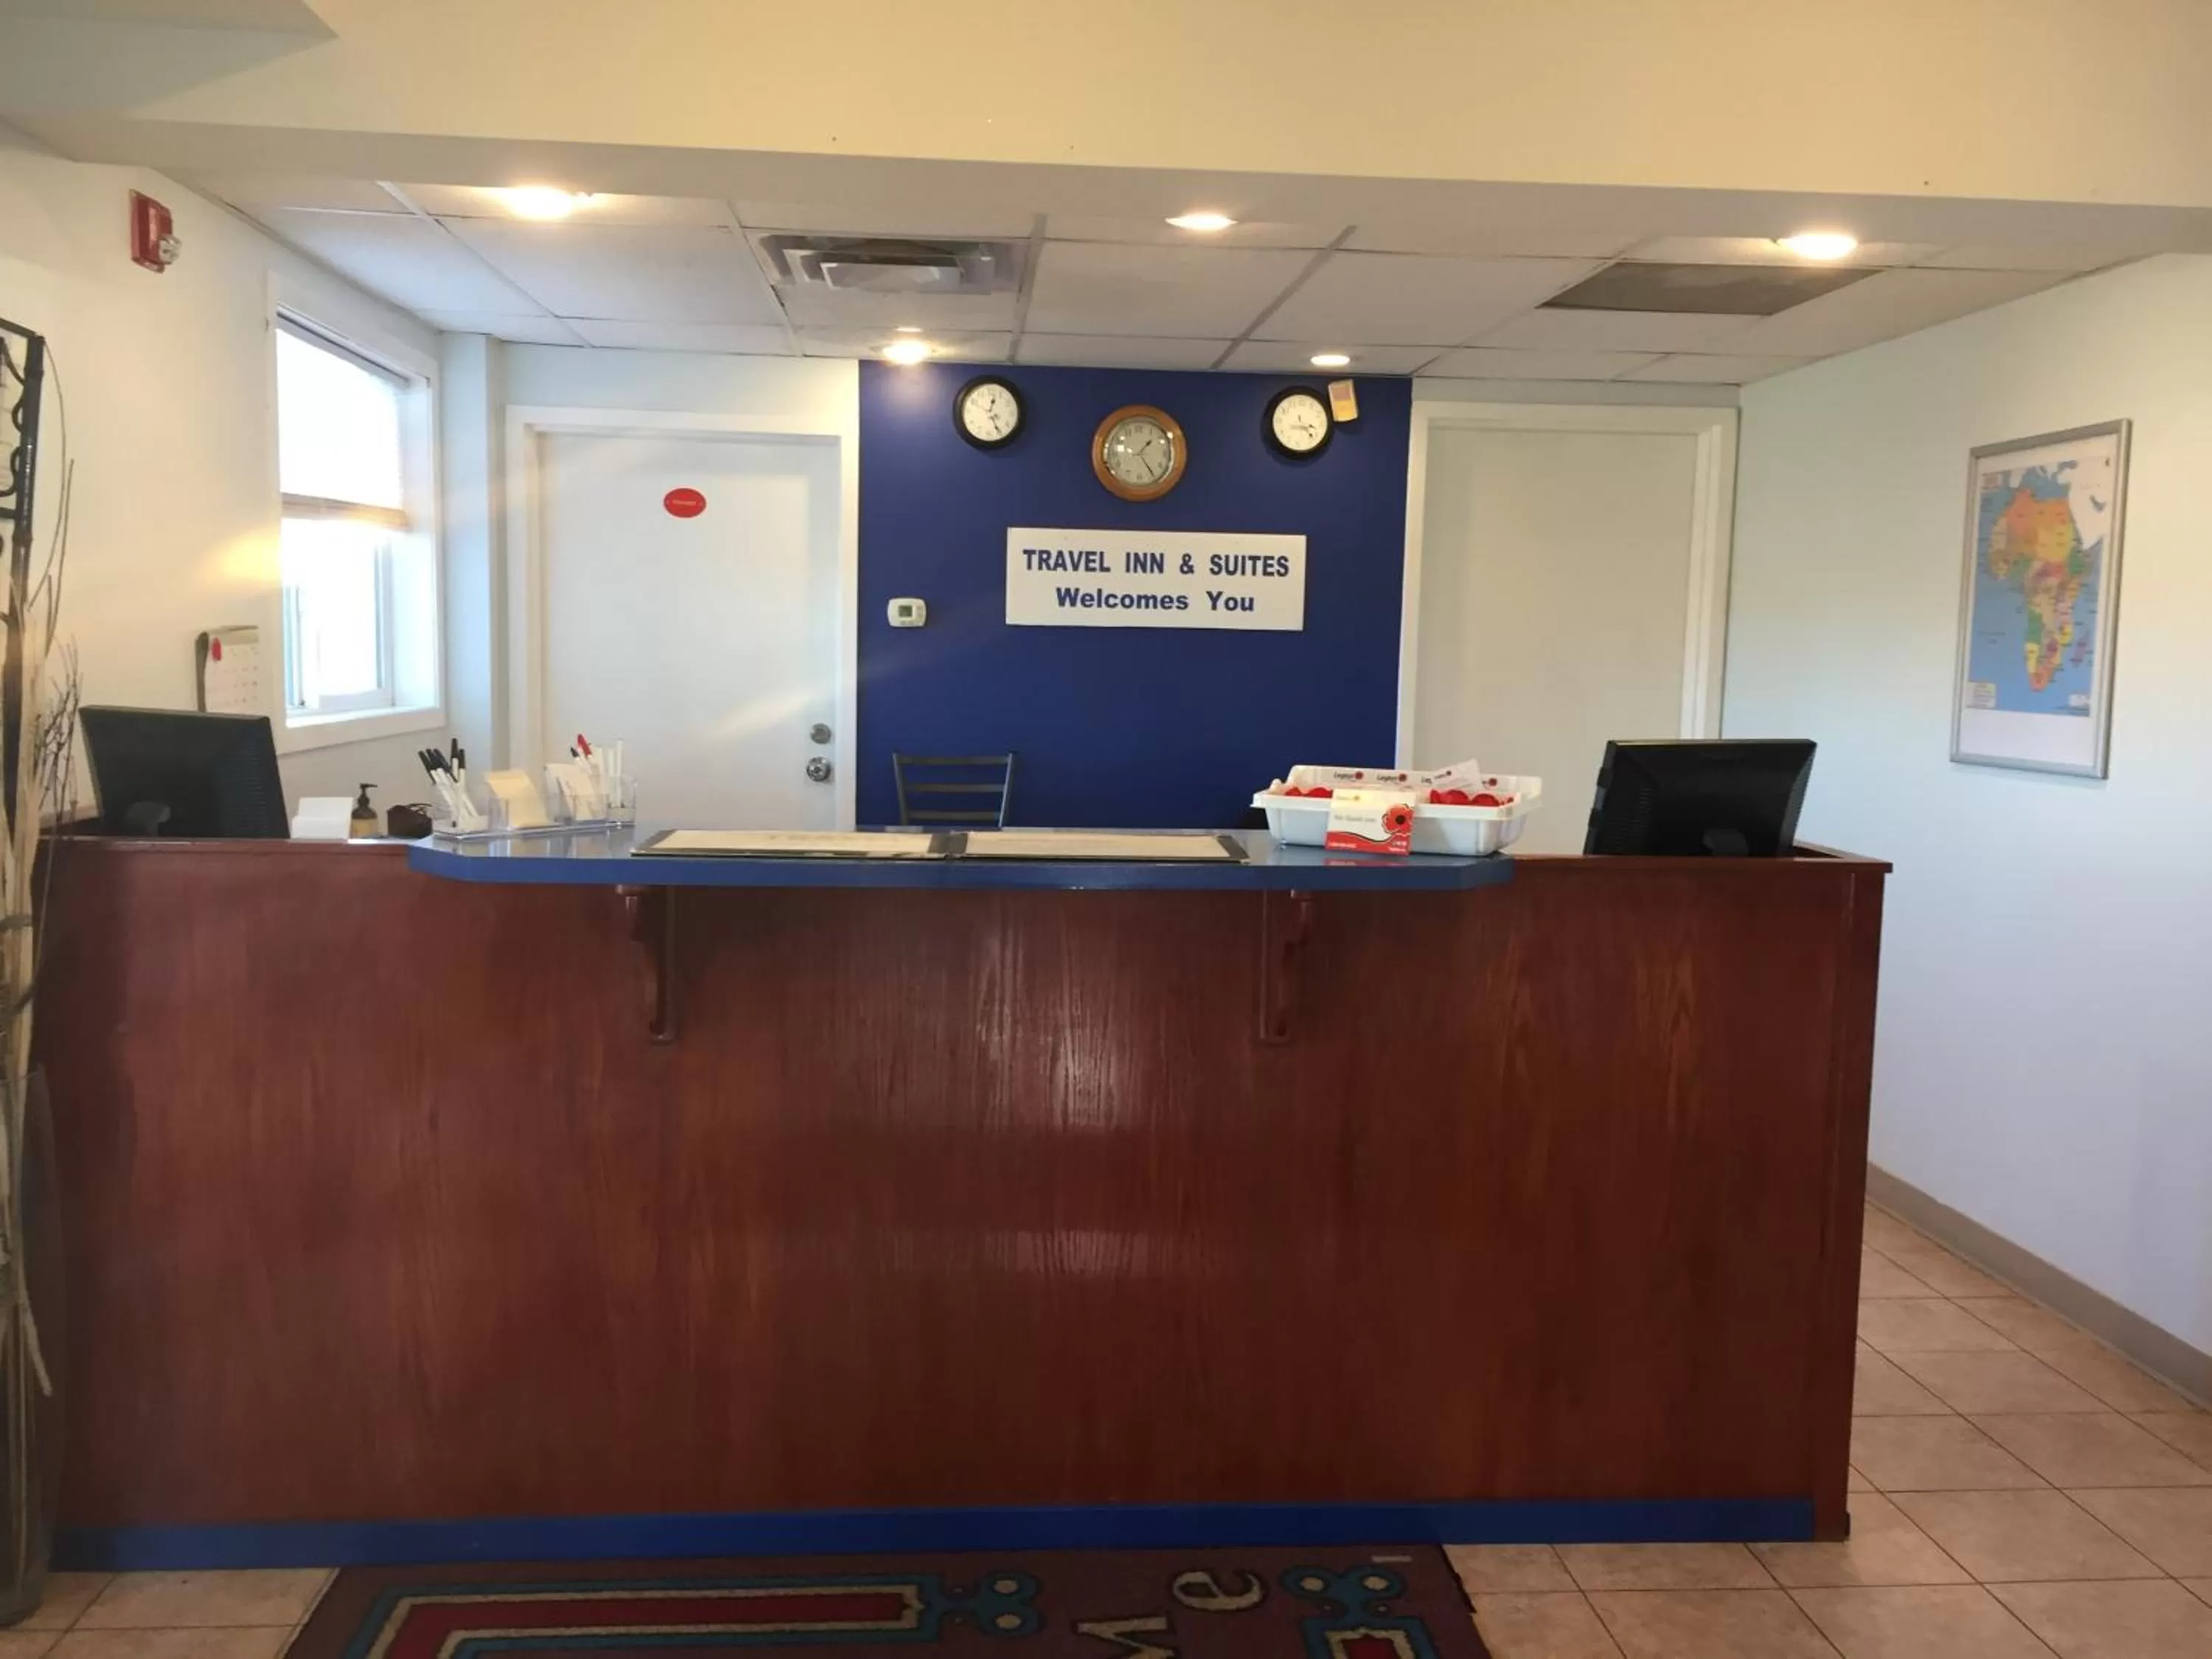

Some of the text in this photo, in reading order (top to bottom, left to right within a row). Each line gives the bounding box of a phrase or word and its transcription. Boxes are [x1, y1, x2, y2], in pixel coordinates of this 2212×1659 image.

[1023, 549, 1290, 577] TRAVEL INN & SUITES
[1056, 587, 1255, 611] Welcomes You
